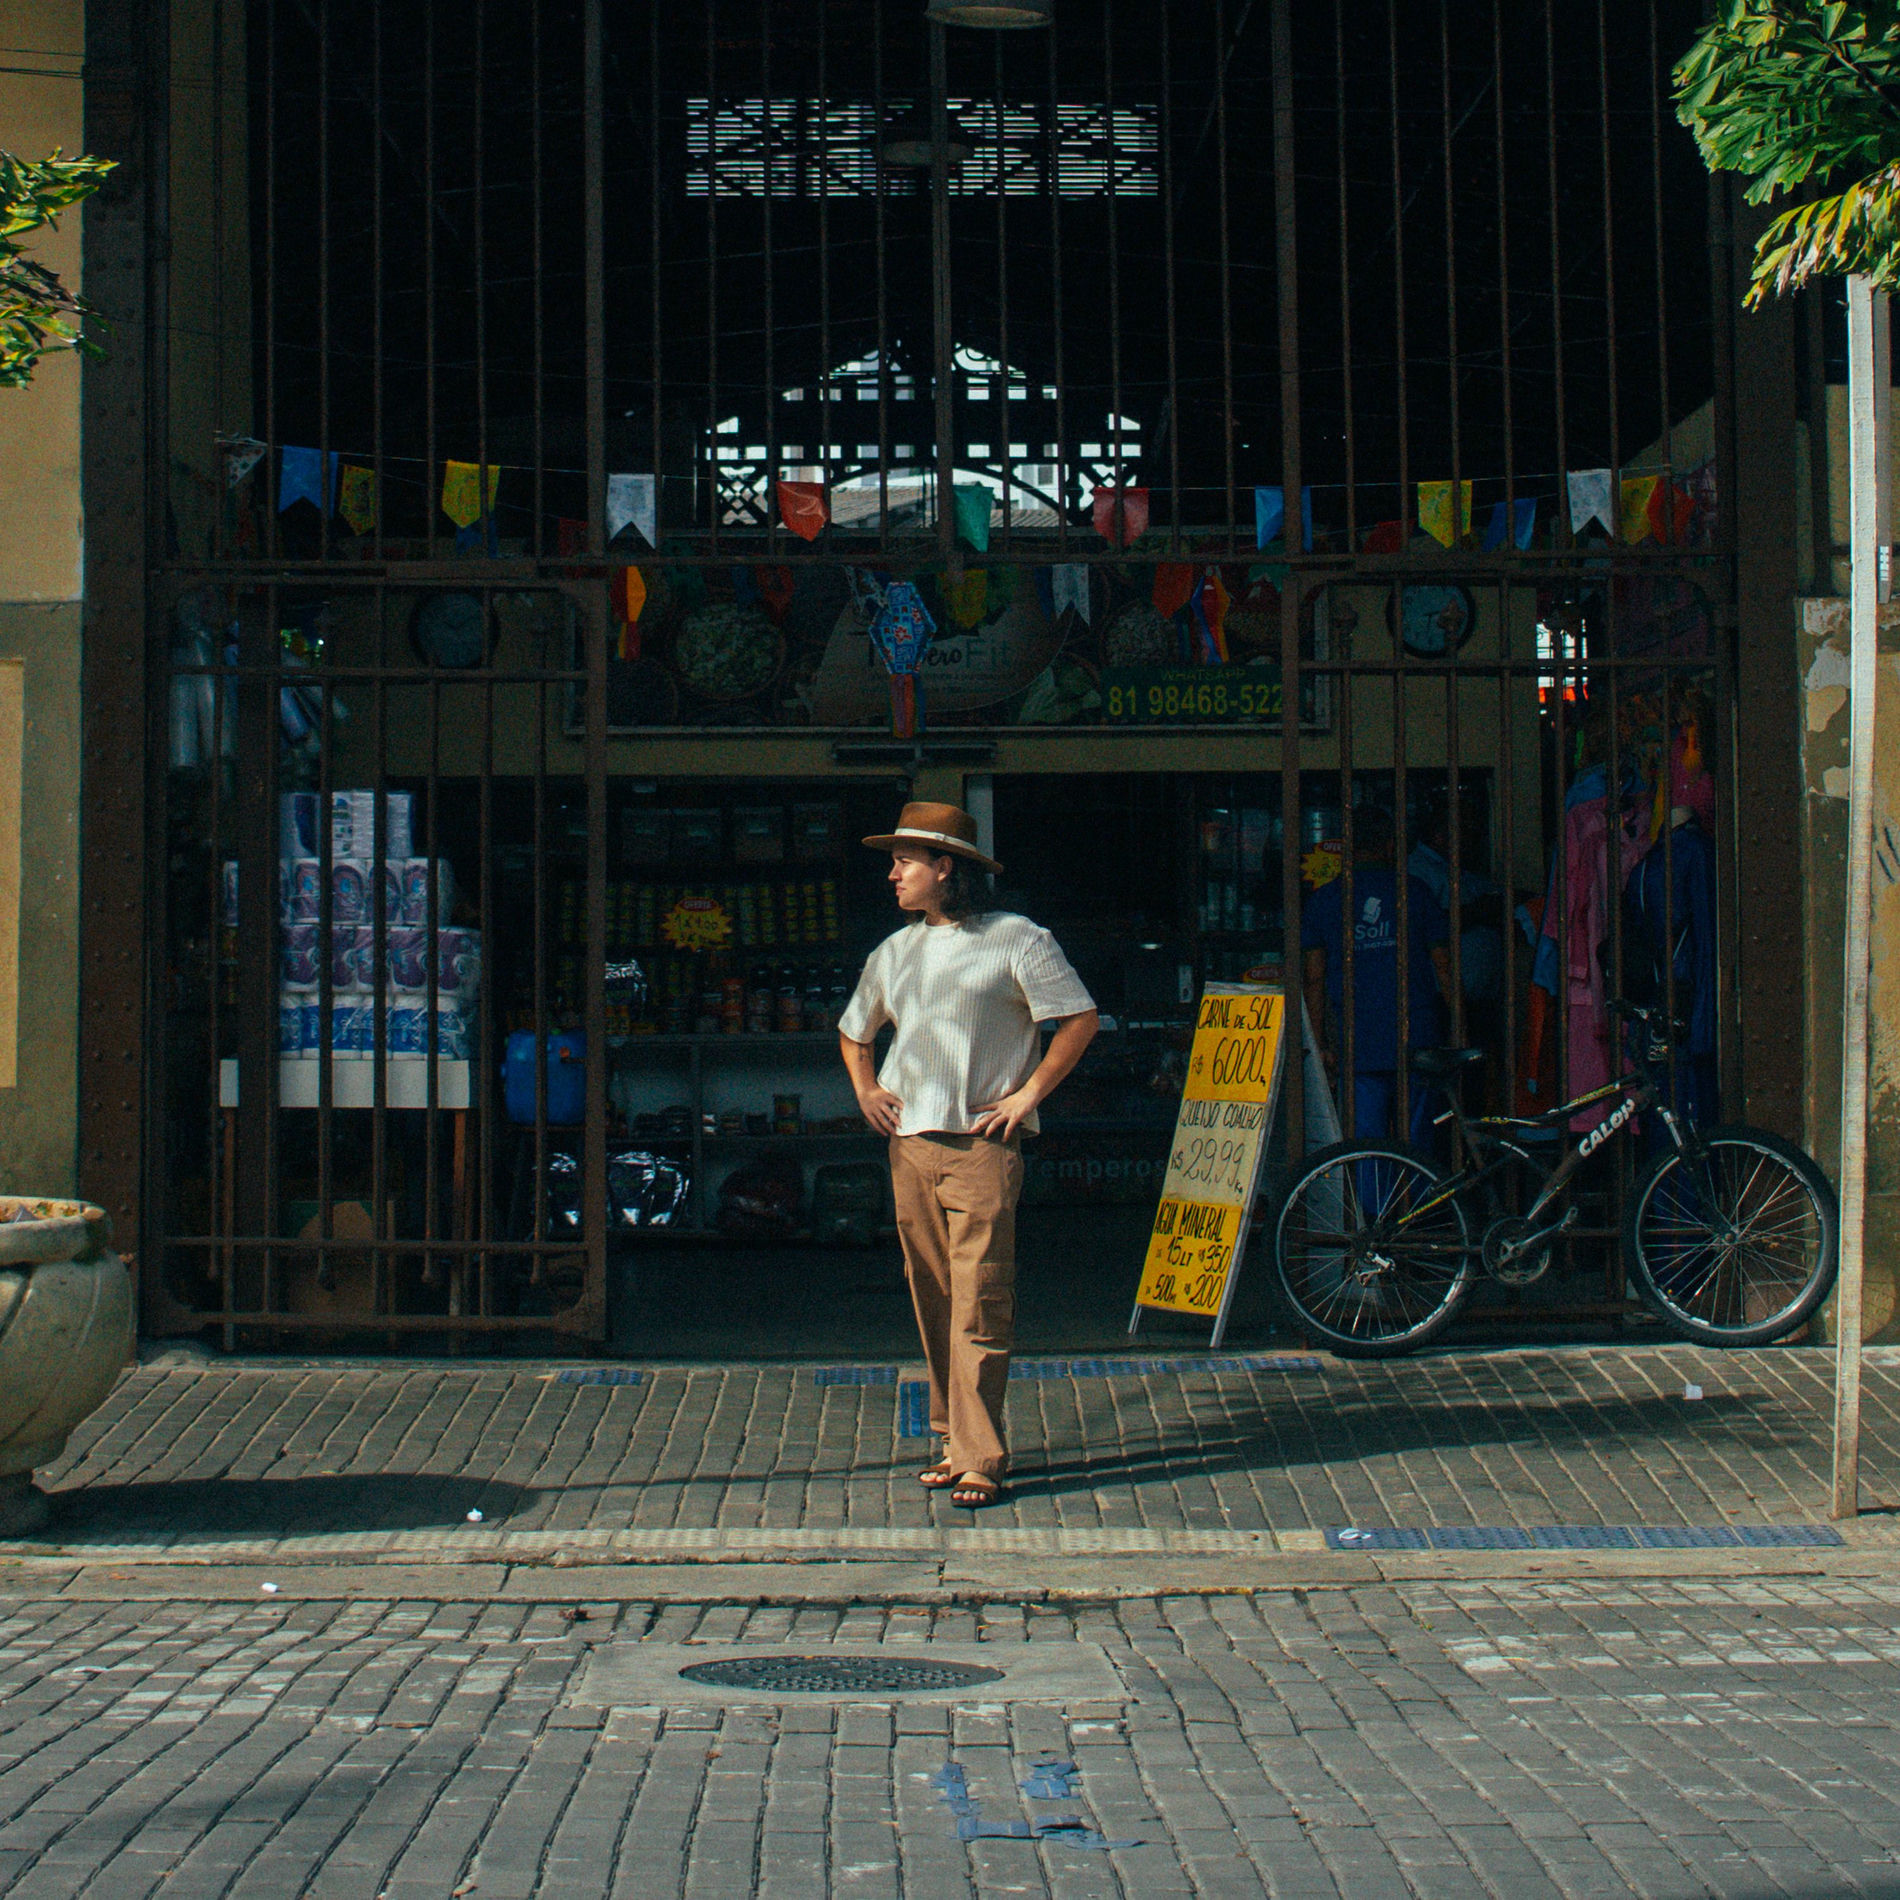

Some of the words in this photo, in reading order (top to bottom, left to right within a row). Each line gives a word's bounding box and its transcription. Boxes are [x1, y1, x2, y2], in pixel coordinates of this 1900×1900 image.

[1107, 685, 1138, 717] 81
[1149, 684, 1283, 717] 98468-522
[1198, 998, 1234, 1030] CARNE
[1234, 1014, 1246, 1029] DE
[1248, 996, 1275, 1031] SOL
[1223, 1103, 1264, 1129] COALHO
[1178, 1203, 1228, 1243] MINERAL
